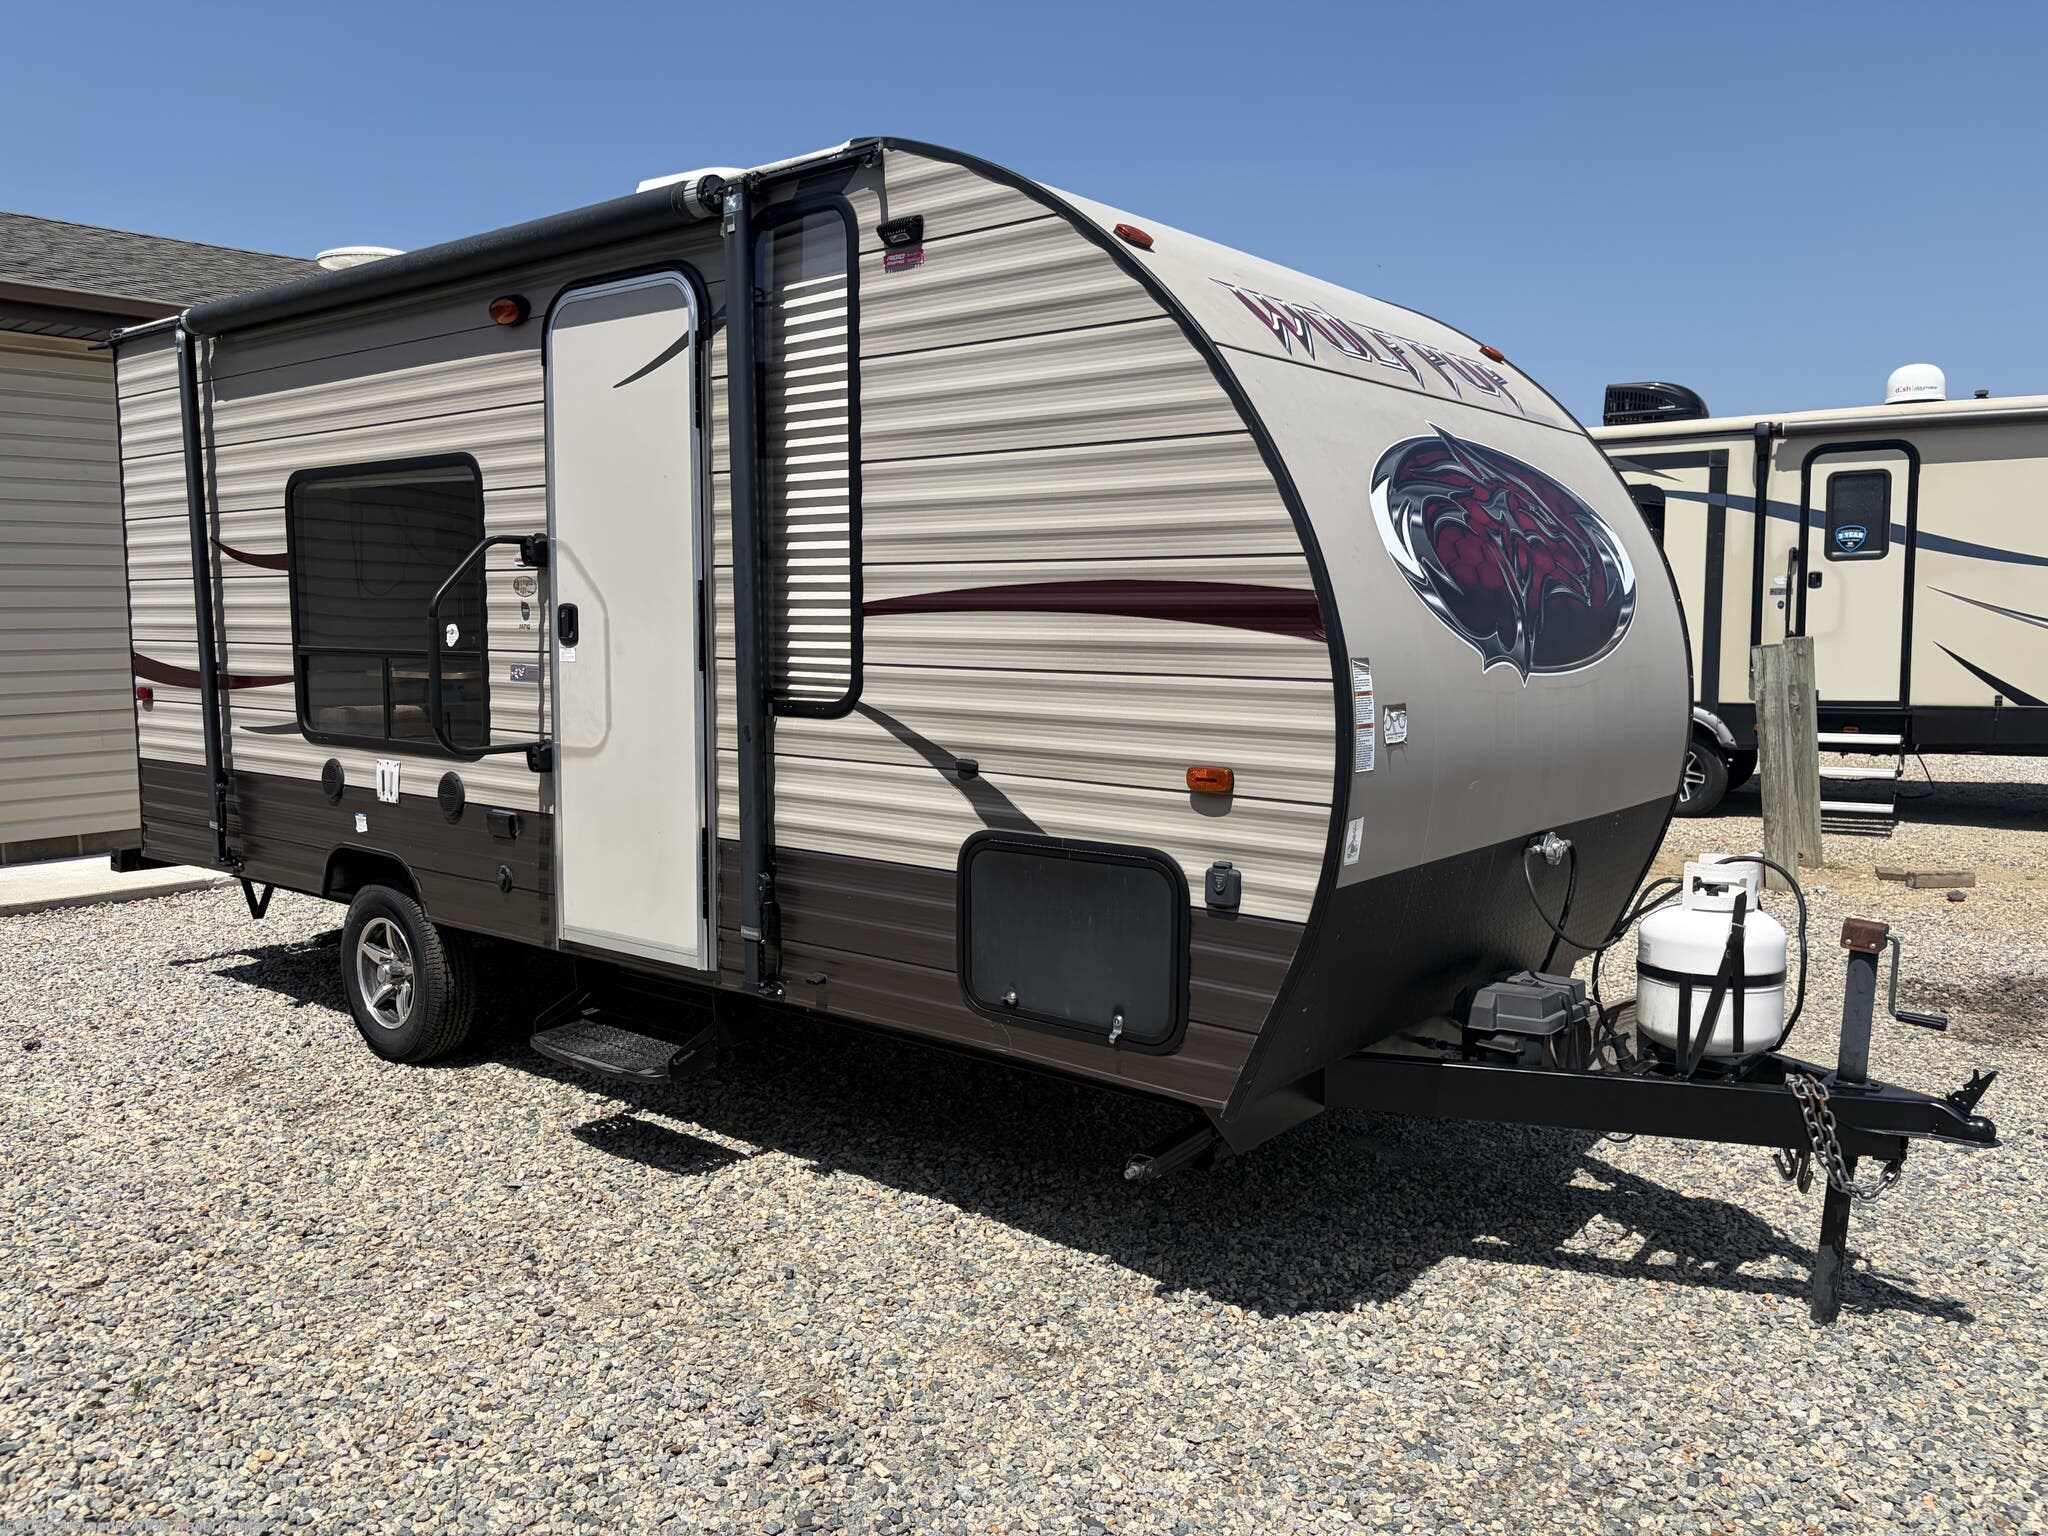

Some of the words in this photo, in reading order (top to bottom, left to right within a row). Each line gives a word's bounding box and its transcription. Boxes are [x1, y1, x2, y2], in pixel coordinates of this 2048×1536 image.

[1208, 277, 1426, 390] WOLF
[1392, 332, 1526, 416] PUP
[1844, 531, 1864, 539] YEAR
